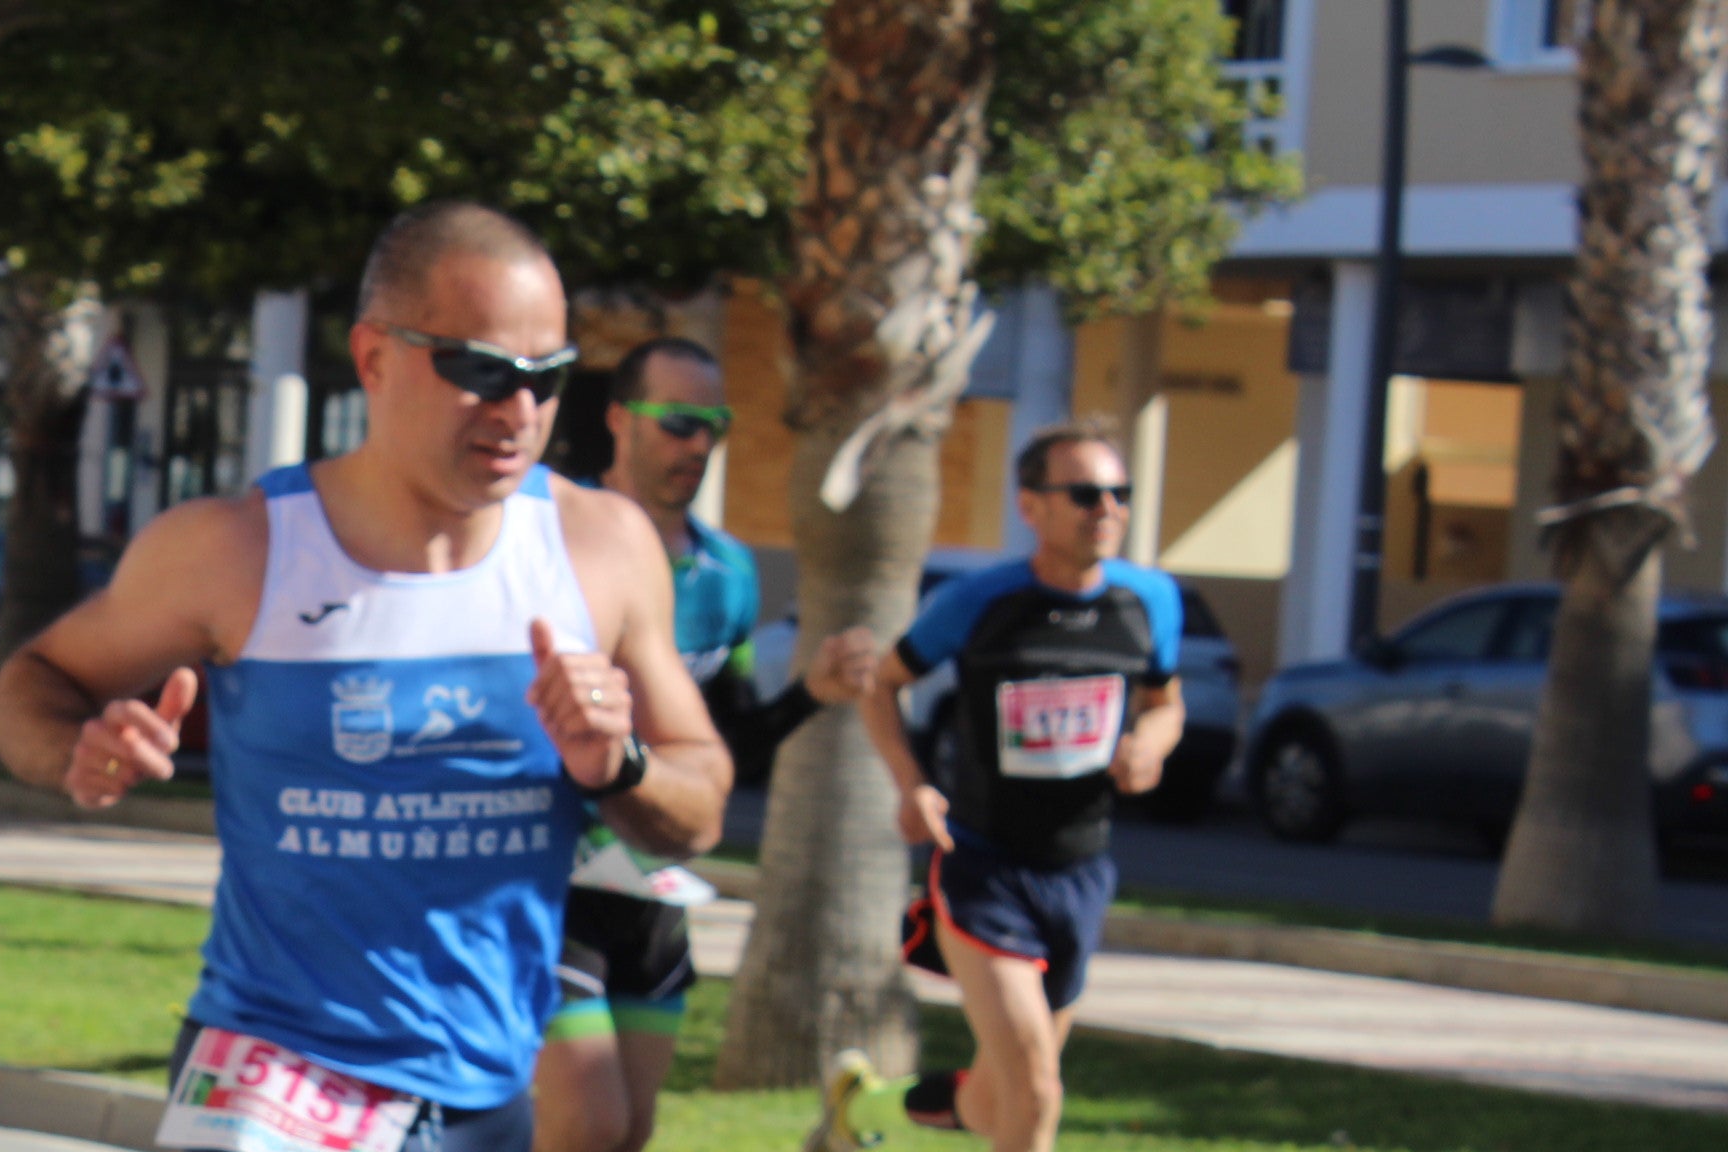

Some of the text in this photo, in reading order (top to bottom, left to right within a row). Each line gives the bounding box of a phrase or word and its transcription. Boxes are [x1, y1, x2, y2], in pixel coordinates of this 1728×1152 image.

[279, 786, 552, 820] CLUB ATLETISMO
[237, 1043, 340, 1123] 515
